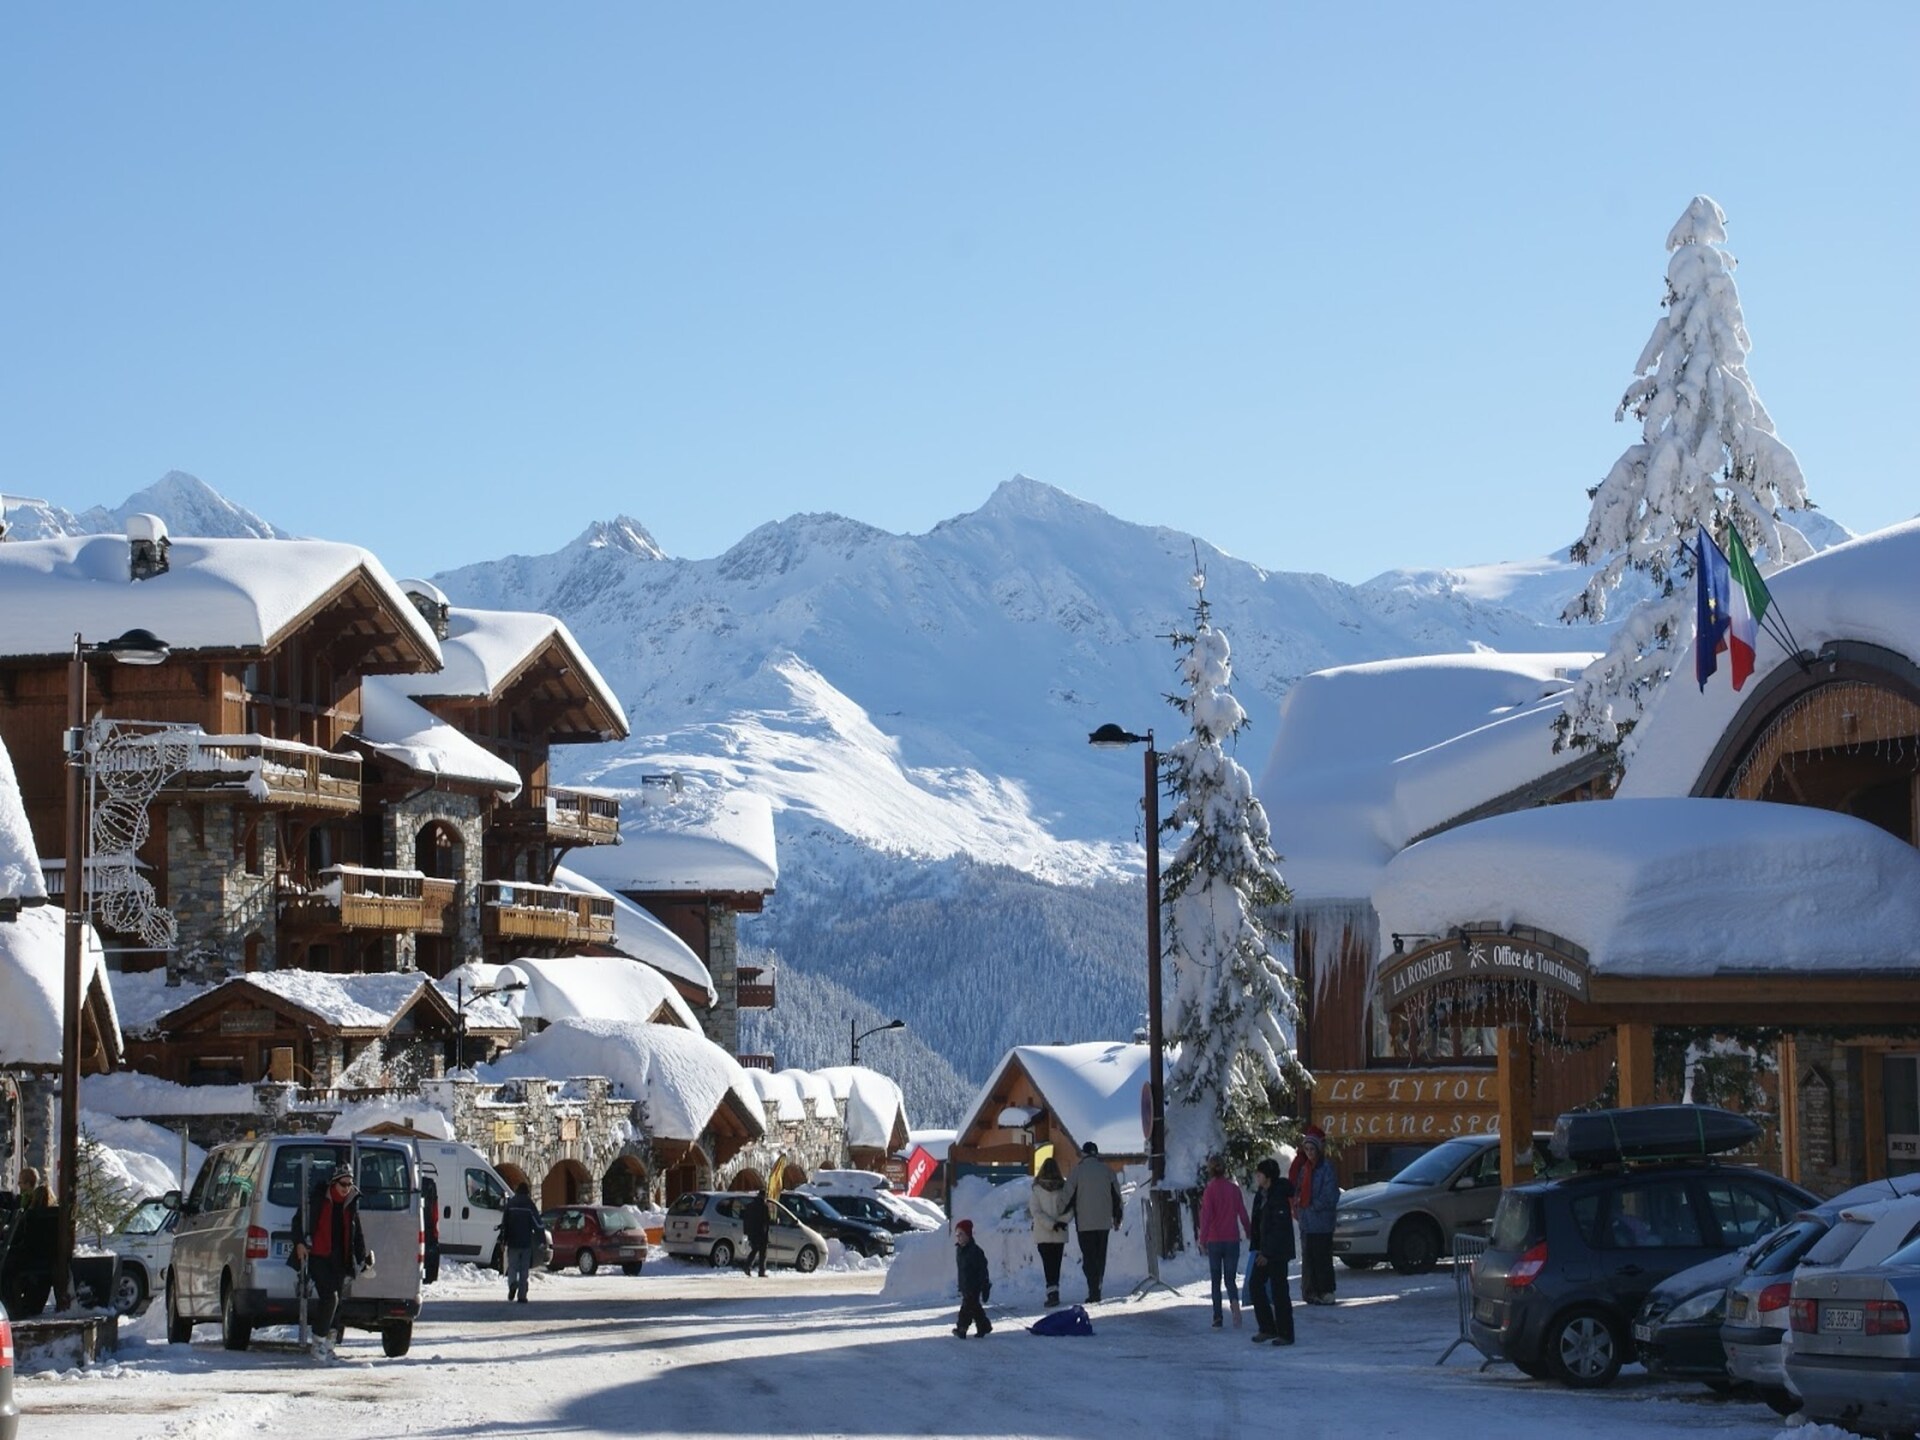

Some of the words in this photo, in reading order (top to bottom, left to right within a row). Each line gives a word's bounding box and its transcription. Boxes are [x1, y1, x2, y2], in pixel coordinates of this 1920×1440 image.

[1392, 973, 1407, 995] LA
[1407, 950, 1453, 985] ROSIÈRE
[1493, 945, 1521, 968] Office
[1522, 949, 1535, 971] de
[1536, 952, 1582, 991] Tourisme
[1330, 1078, 1366, 1100] Le
[1388, 1077, 1488, 1102] Tyrol
